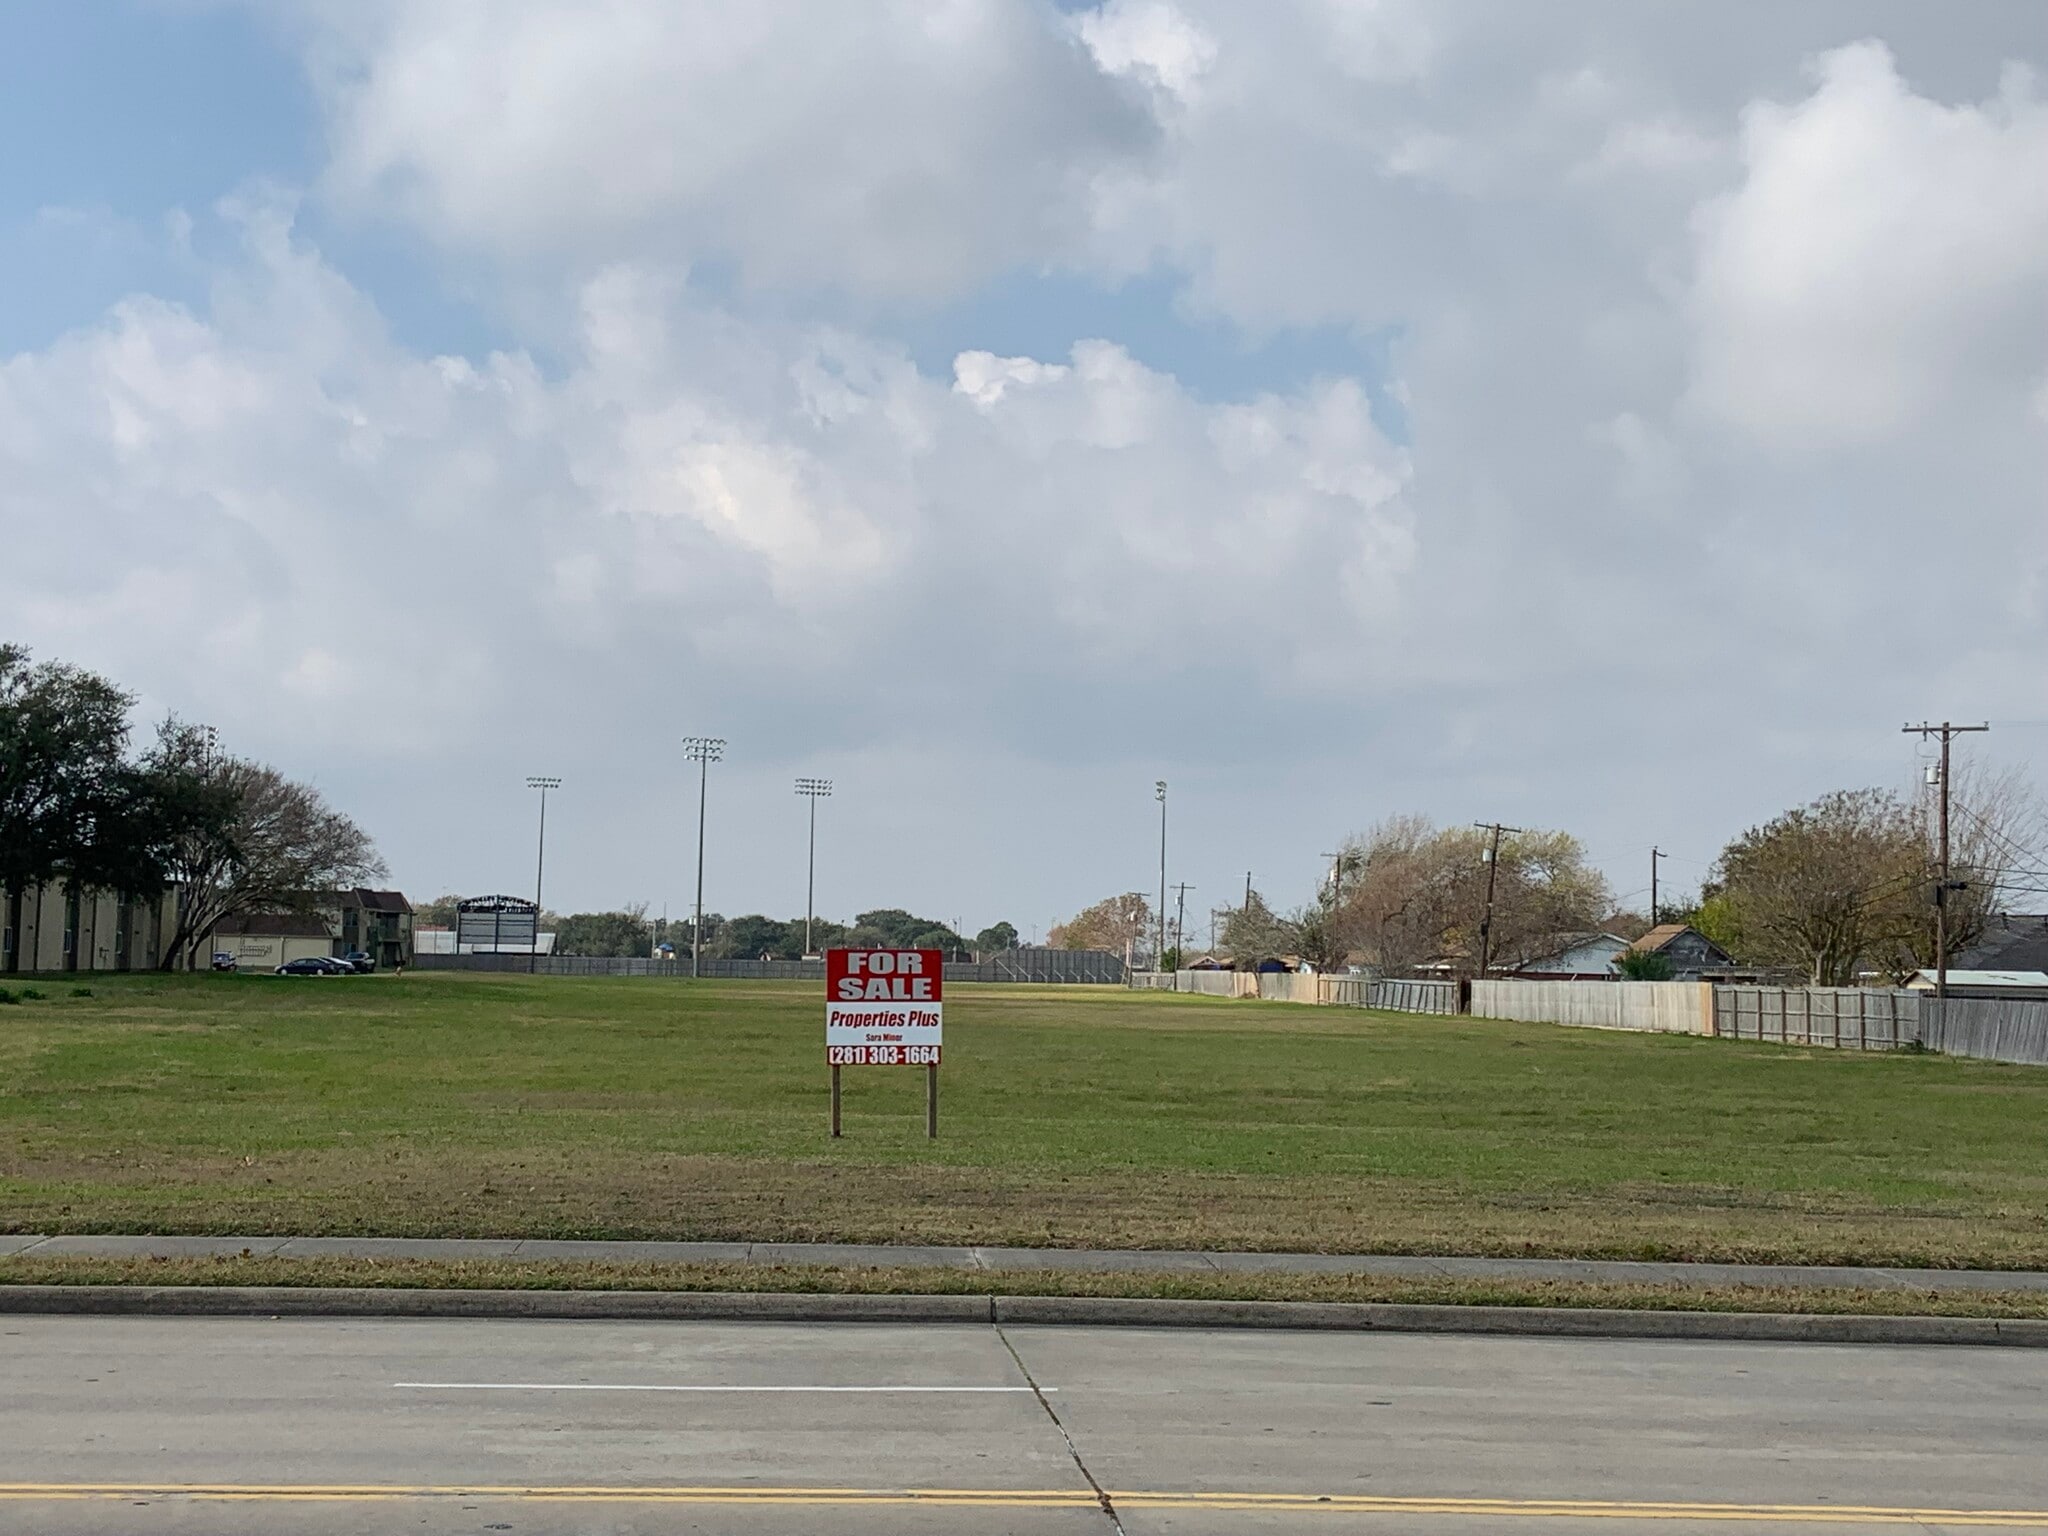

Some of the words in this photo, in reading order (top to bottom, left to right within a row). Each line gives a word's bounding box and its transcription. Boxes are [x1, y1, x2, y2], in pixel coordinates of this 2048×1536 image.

[848, 952, 922, 974] FOR
[838, 977, 932, 1000] SALE
[830, 1010, 905, 1028] Properties
[908, 1010, 939, 1027] Plus
[829, 1047, 866, 1064] (281)
[869, 1047, 939, 1064] 303-1664
